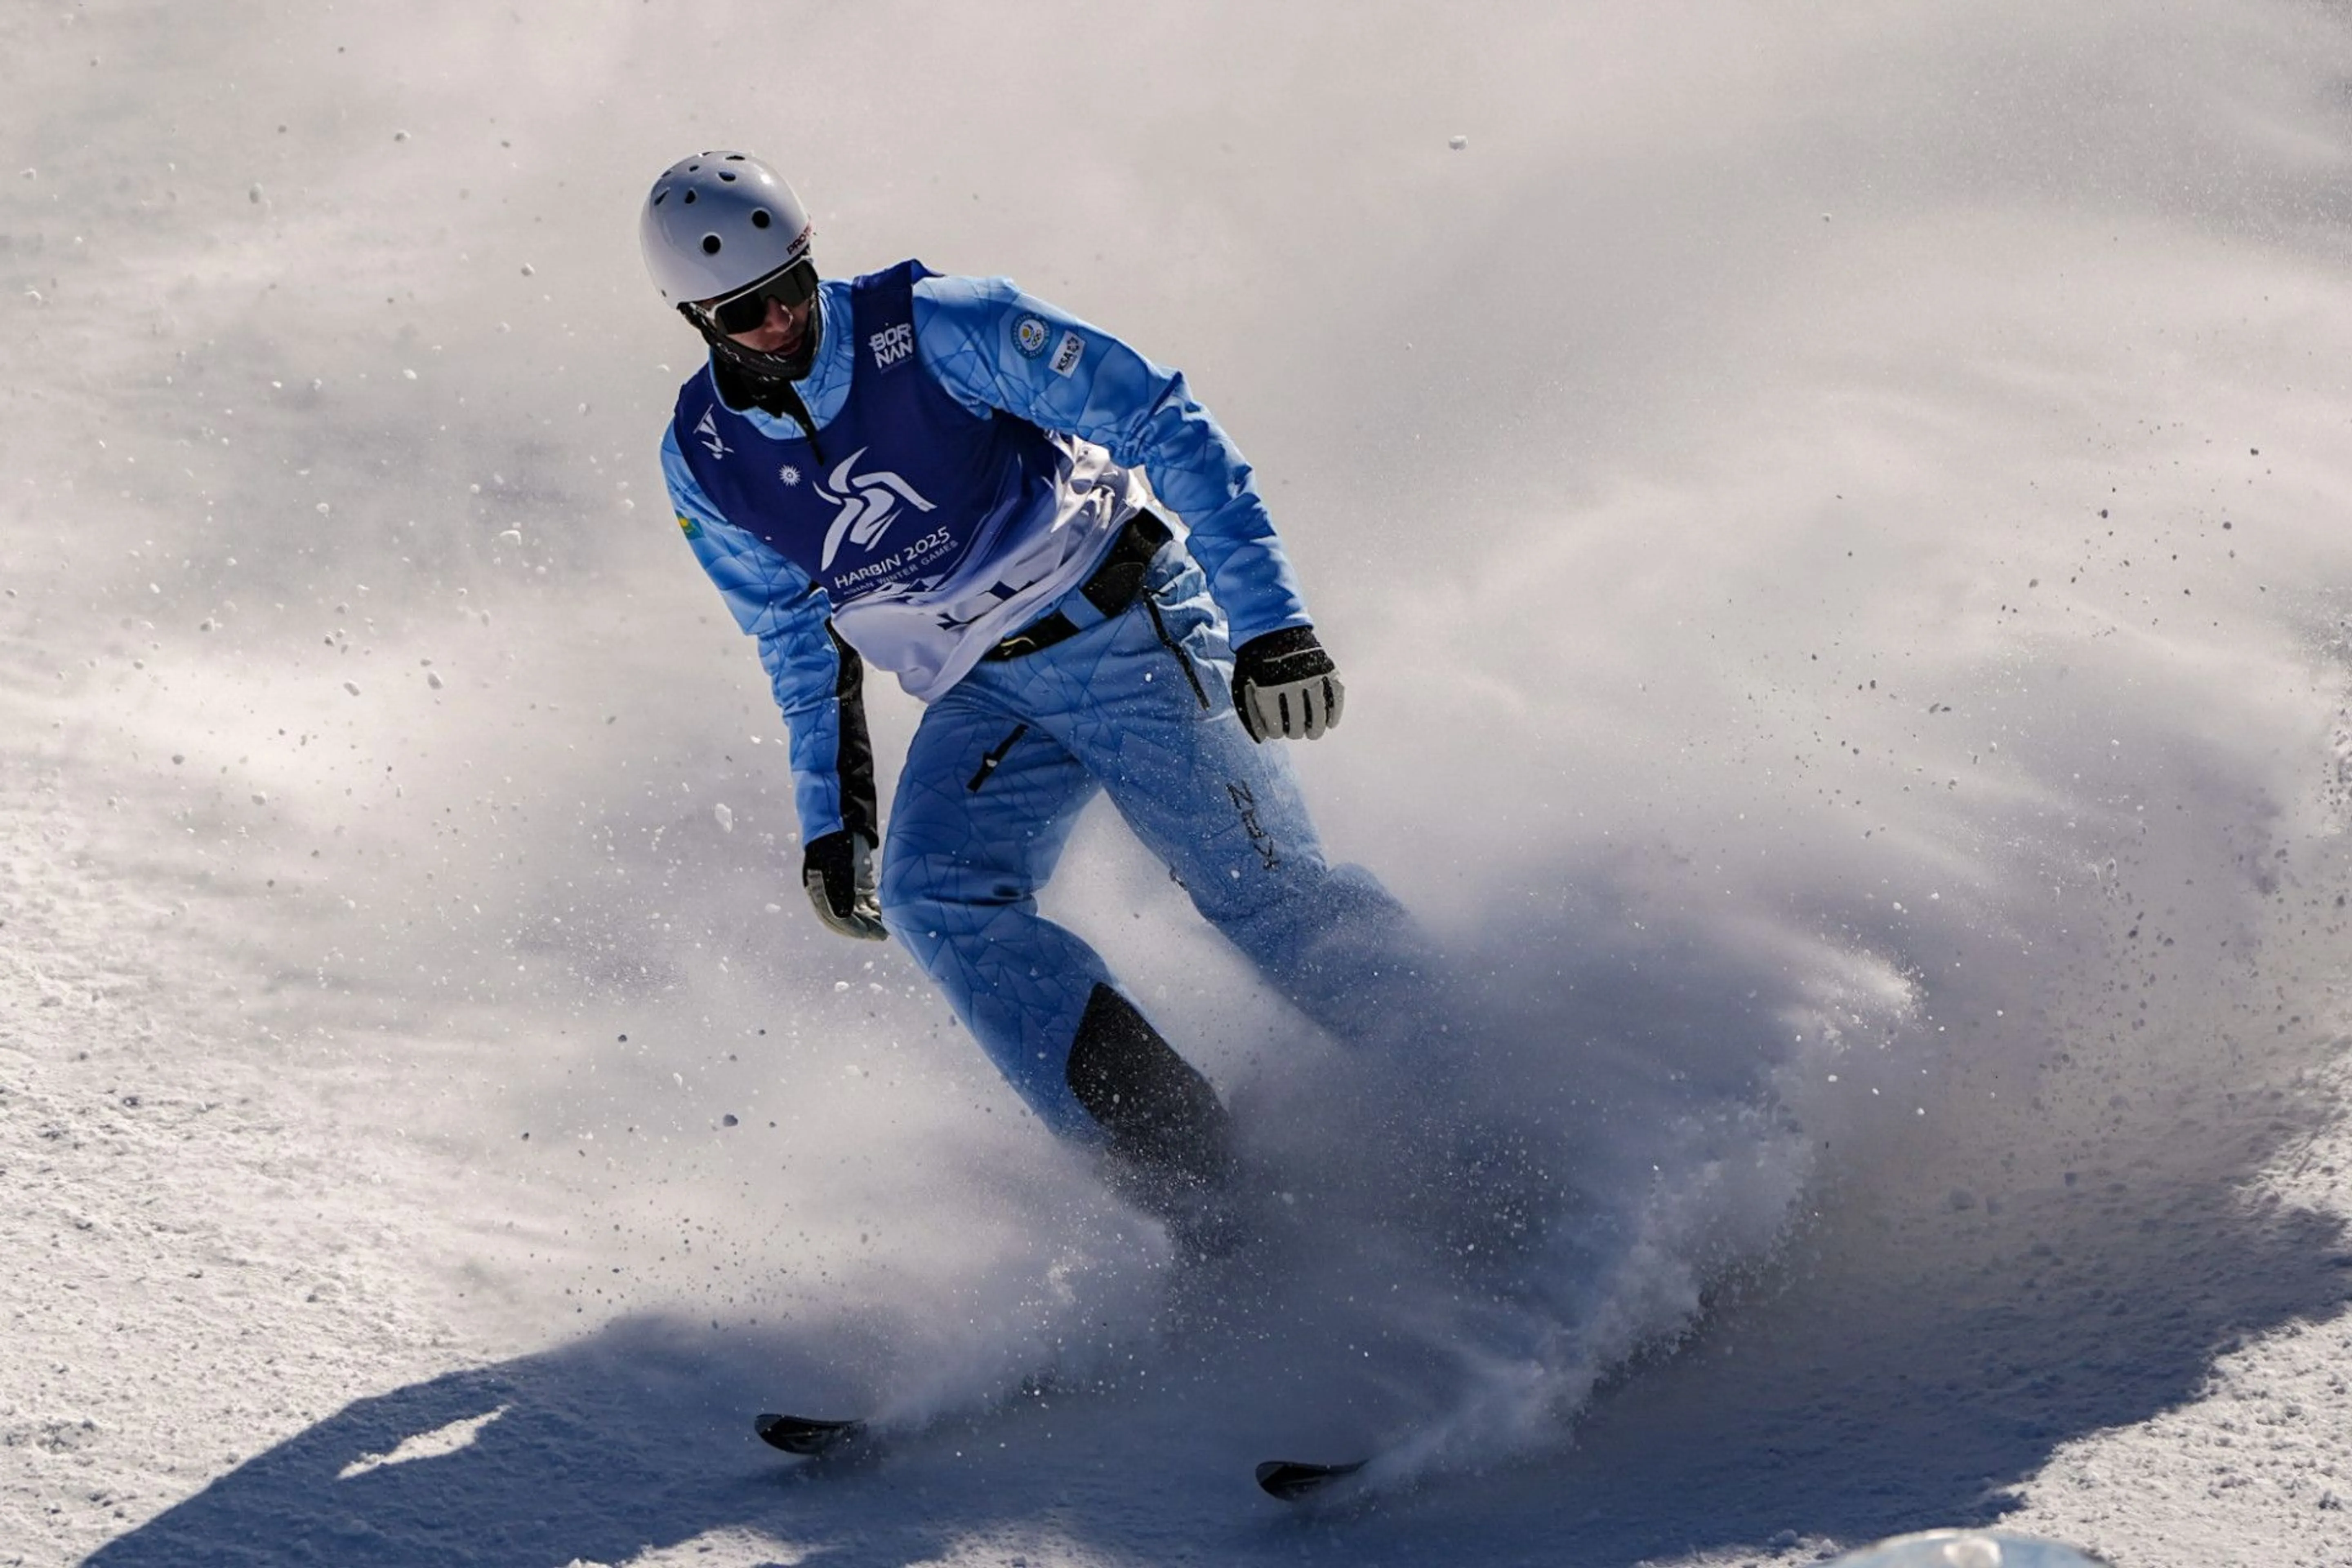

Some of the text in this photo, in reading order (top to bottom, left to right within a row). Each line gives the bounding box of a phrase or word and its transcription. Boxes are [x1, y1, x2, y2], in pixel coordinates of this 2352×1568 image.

[875, 338, 913, 369] NAN
[834, 526, 951, 588] HARBIN 2025
[877, 564, 919, 585] WINTER
[920, 539, 959, 566] GAMES
